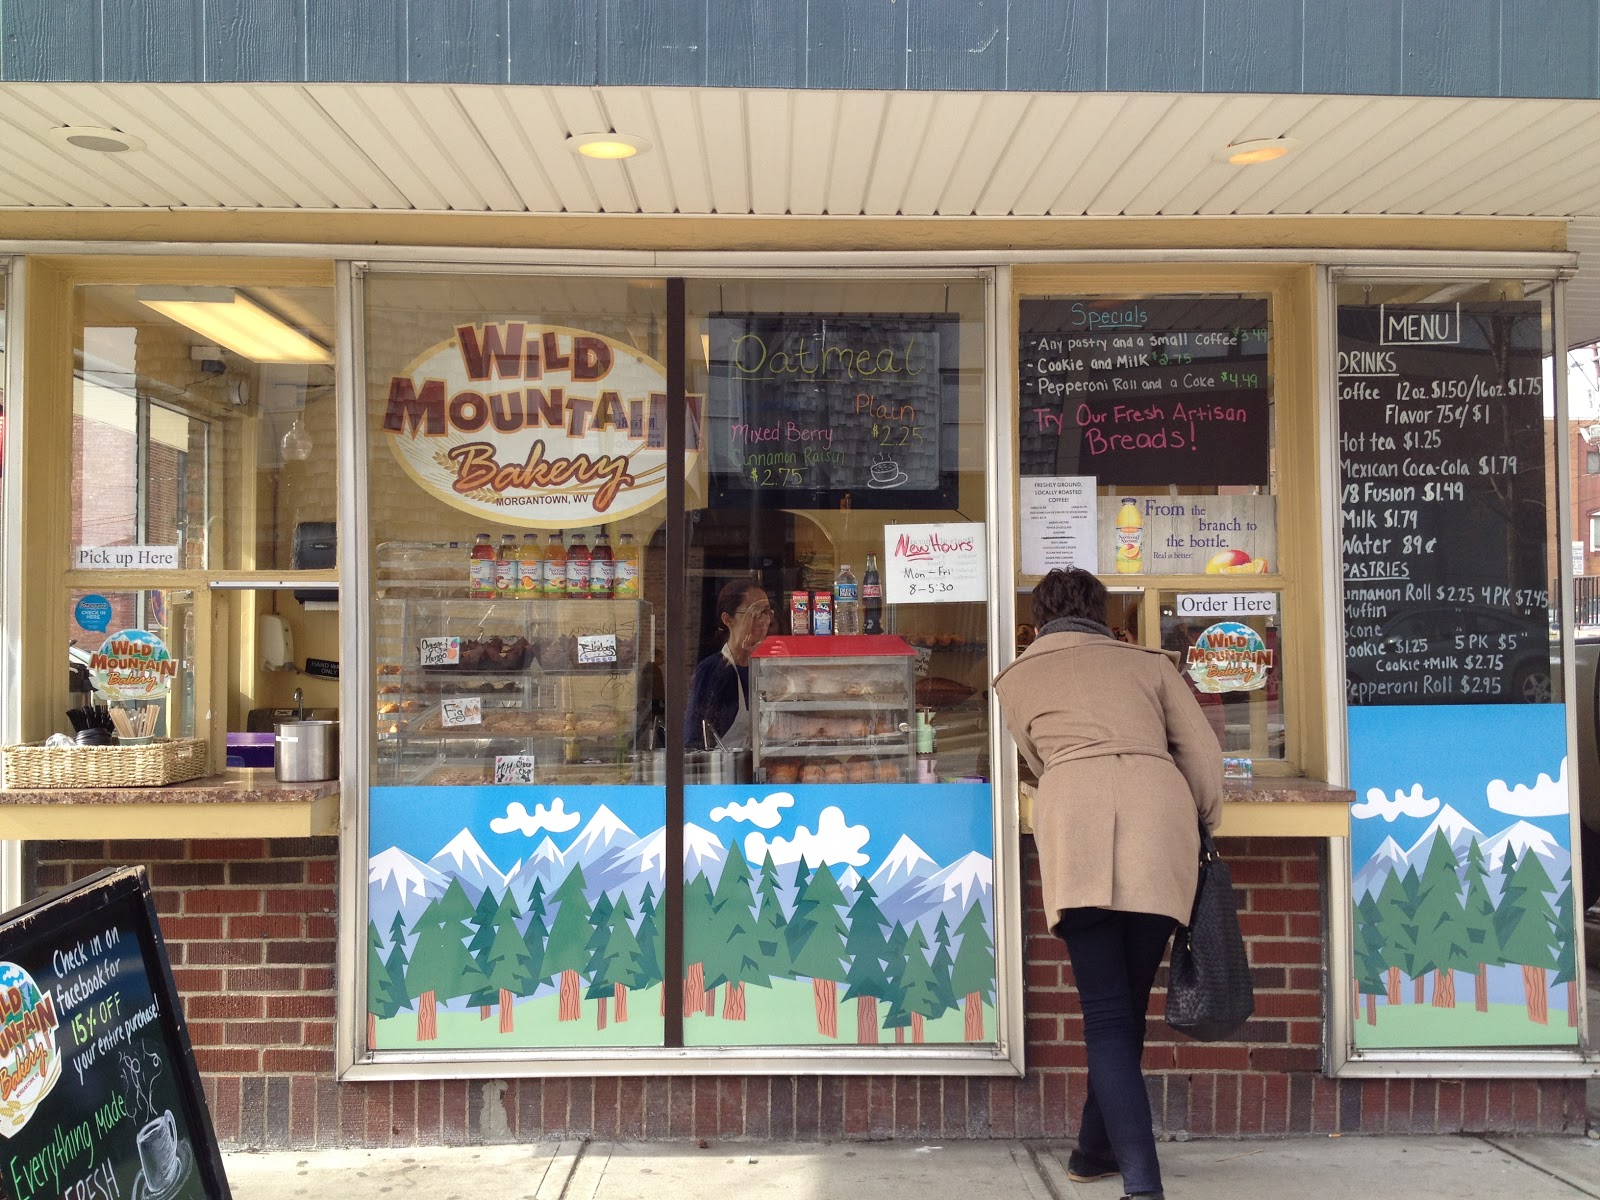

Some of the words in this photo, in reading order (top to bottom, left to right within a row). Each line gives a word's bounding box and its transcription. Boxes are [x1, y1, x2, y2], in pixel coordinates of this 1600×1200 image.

[1071, 303, 1148, 330] Specials
[1388, 314, 1449, 340] MENU
[453, 320, 615, 382] WILD
[1038, 337, 1063, 353] Any
[1068, 335, 1107, 352] pastry
[1112, 336, 1134, 349] and
[1137, 336, 1144, 348] a
[1150, 332, 1188, 348] small
[1195, 333, 1238, 346] Coffee
[731, 334, 924, 378] Oatmeal
[1037, 356, 1084, 374] Cookie
[1090, 357, 1113, 371] and
[1116, 353, 1150, 369] Milk
[1152, 350, 1192, 366] $2.75
[1338, 350, 1397, 374] DRINKS
[1038, 379, 1108, 397] Pepperoni
[1114, 378, 1138, 392] Roll
[1141, 377, 1162, 390] and
[1170, 379, 1178, 388] a
[1182, 373, 1215, 388] Coke
[1220, 371, 1258, 389] $4.49
[1508, 377, 1542, 396] $1.75
[381, 375, 706, 452] MOUNTAIN
[856, 394, 915, 422] Plain
[1033, 408, 1064, 436] Try
[1076, 402, 1107, 426] Our
[1114, 404, 1164, 424] Fresh
[1172, 402, 1248, 423] Artisan
[1386, 404, 1433, 425] Flavor
[731, 420, 780, 444] Mixed
[786, 422, 833, 450] Berry
[872, 424, 925, 447] $2.25
[1085, 421, 1198, 456] Breads!
[1369, 432, 1396, 452] tea
[1403, 429, 1442, 450] $1.25
[732, 448, 796, 467] Cinnamon
[804, 446, 844, 465] Raisin
[1340, 458, 1398, 478] Mexican
[1402, 457, 1470, 478] Coca-Cola
[1478, 456, 1517, 476] $1.79
[448, 439, 635, 512] Bakery
[750, 467, 808, 487] $2.75
[496, 495, 571, 506] MORGANTOWN,
[573, 494, 588, 504] WV
[1364, 482, 1415, 502] Fusion
[1422, 482, 1464, 503] $1.49
[1144, 499, 1185, 516] From
[1191, 506, 1206, 516] the
[1199, 518, 1242, 532] branch
[1246, 522, 1258, 532] to
[1342, 509, 1378, 529] Milk
[1384, 509, 1418, 530] $1.79
[894, 533, 930, 557] New
[930, 533, 974, 553] Hours
[1166, 534, 1185, 548] the
[1190, 534, 1230, 548] bottle.
[1342, 532, 1392, 554] Water
[79, 550, 110, 564] Pick
[116, 553, 134, 568] up
[138, 550, 173, 564] Here
[904, 568, 926, 579] Mon
[938, 566, 951, 576] Fri
[1182, 596, 1228, 612] Order
[1232, 596, 1272, 612] Here
[1406, 583, 1431, 601] Roll
[1436, 586, 1475, 603] $2.25
[1344, 602, 1387, 618] Muffin
[111, 640, 152, 656] WILD
[1206, 634, 1248, 648] WILD
[1394, 639, 1428, 654] $1.25
[89, 654, 178, 676] MOUNTAIN
[1188, 648, 1272, 666] MOUNTAIN
[1464, 654, 1504, 670] $2.75
[107, 669, 158, 692] Bakery
[1205, 662, 1255, 683] Bakery
[1346, 678, 1418, 704] Pepperoni
[1424, 675, 1452, 694] Roll
[1460, 674, 1502, 694] $2.95
[53, 940, 88, 978] Check
[90, 935, 102, 956] in
[106, 926, 120, 949] on
[56, 965, 106, 1016] facebook
[104, 958, 120, 980] for
[0, 985, 22, 1026] LD
[100, 992, 120, 1024] OFF
[0, 996, 57, 1059] UNTAIN
[73, 1042, 96, 1086] your
[98, 1025, 125, 1056] entire
[124, 992, 161, 1045] purchase!
[0, 1042, 48, 1101] Bakery
[10, 1122, 94, 1200] Everything
